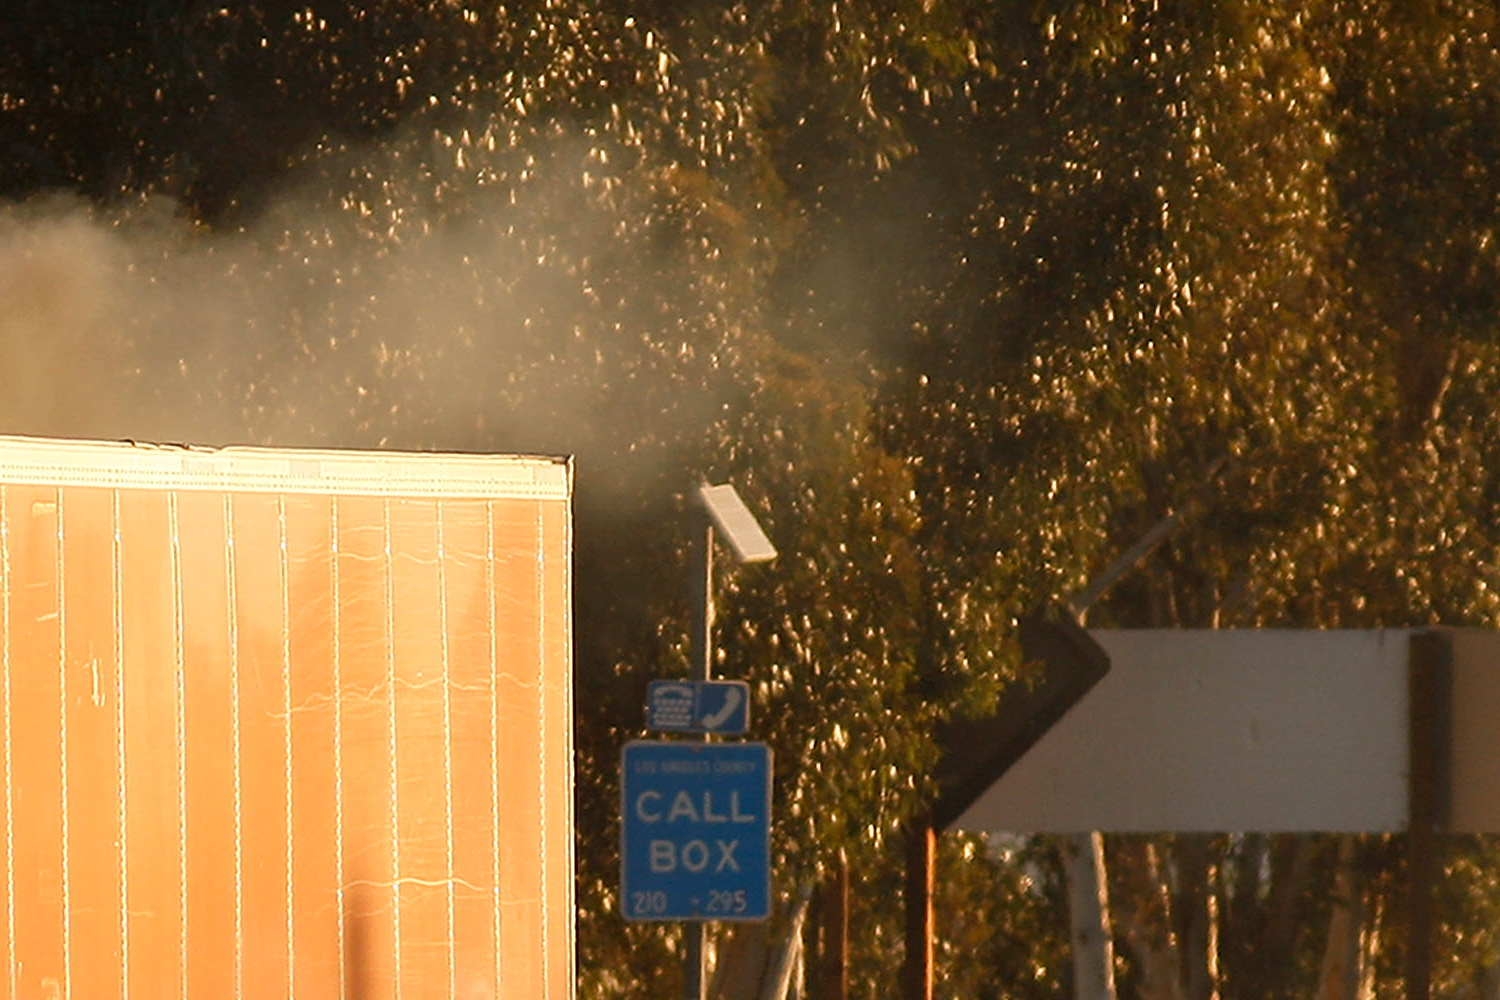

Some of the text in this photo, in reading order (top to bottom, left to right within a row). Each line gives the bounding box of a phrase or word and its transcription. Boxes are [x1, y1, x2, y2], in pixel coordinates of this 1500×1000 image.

[635, 790, 756, 824] CALL
[650, 839, 740, 873] BOX
[632, 890, 668, 914] 210
[706, 888, 747, 912] 295
